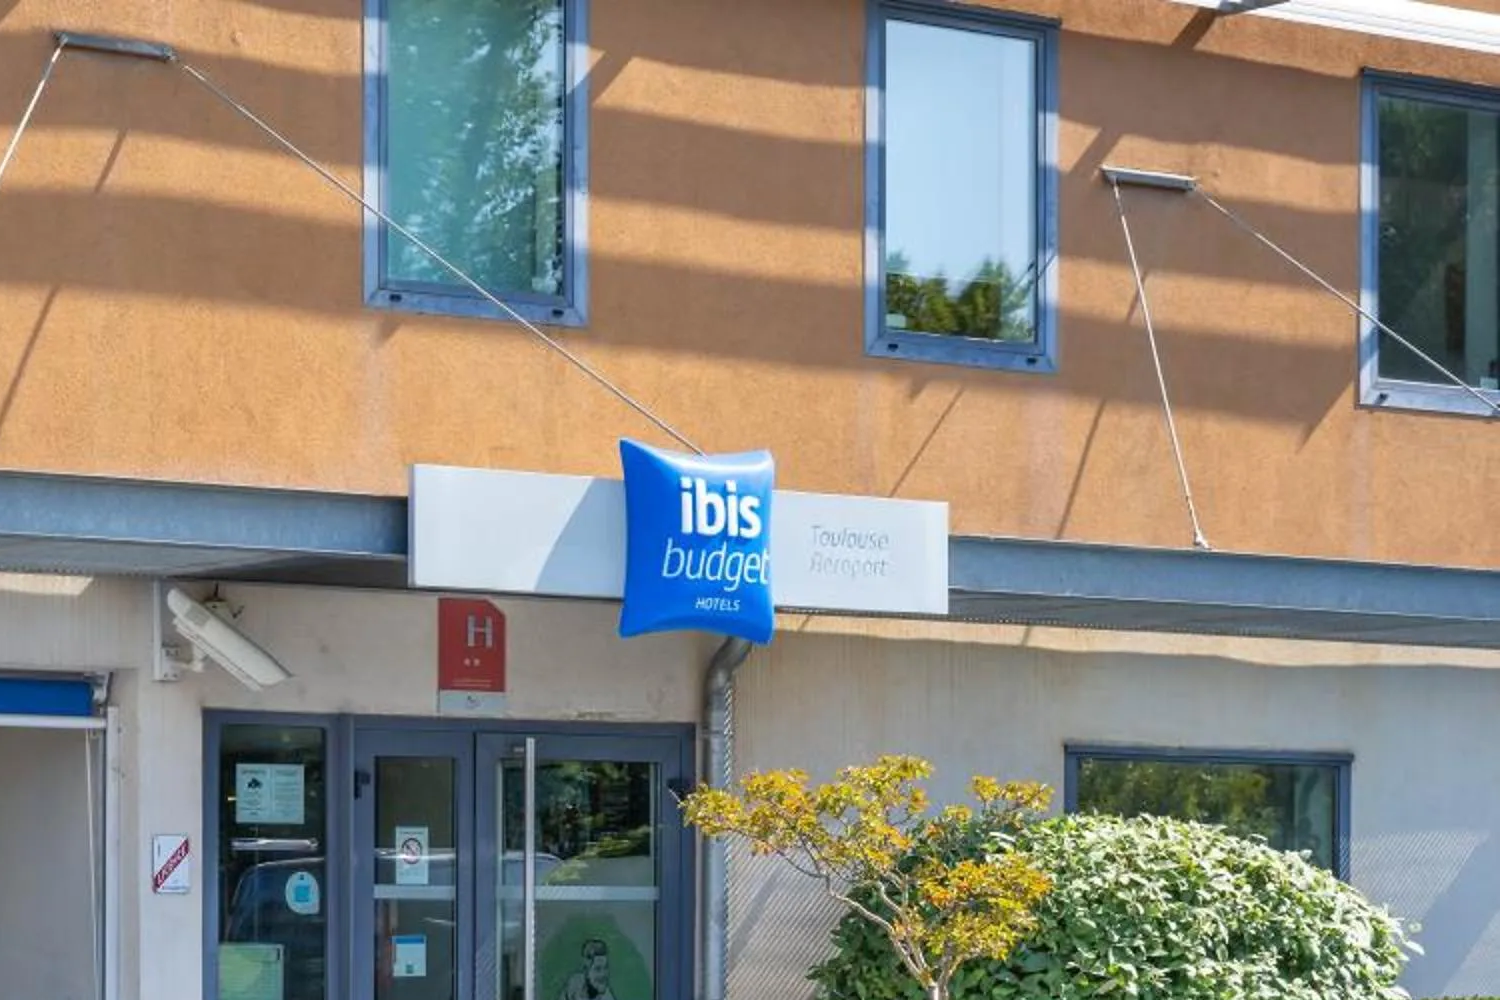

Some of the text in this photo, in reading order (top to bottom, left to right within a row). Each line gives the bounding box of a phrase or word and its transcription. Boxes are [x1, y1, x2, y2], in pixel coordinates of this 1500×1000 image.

[679, 476, 762, 539] ibis
[811, 524, 889, 550] Toulouse
[661, 537, 771, 593] budget
[695, 597, 741, 612] HOTELS
[466, 614, 493, 648] H
